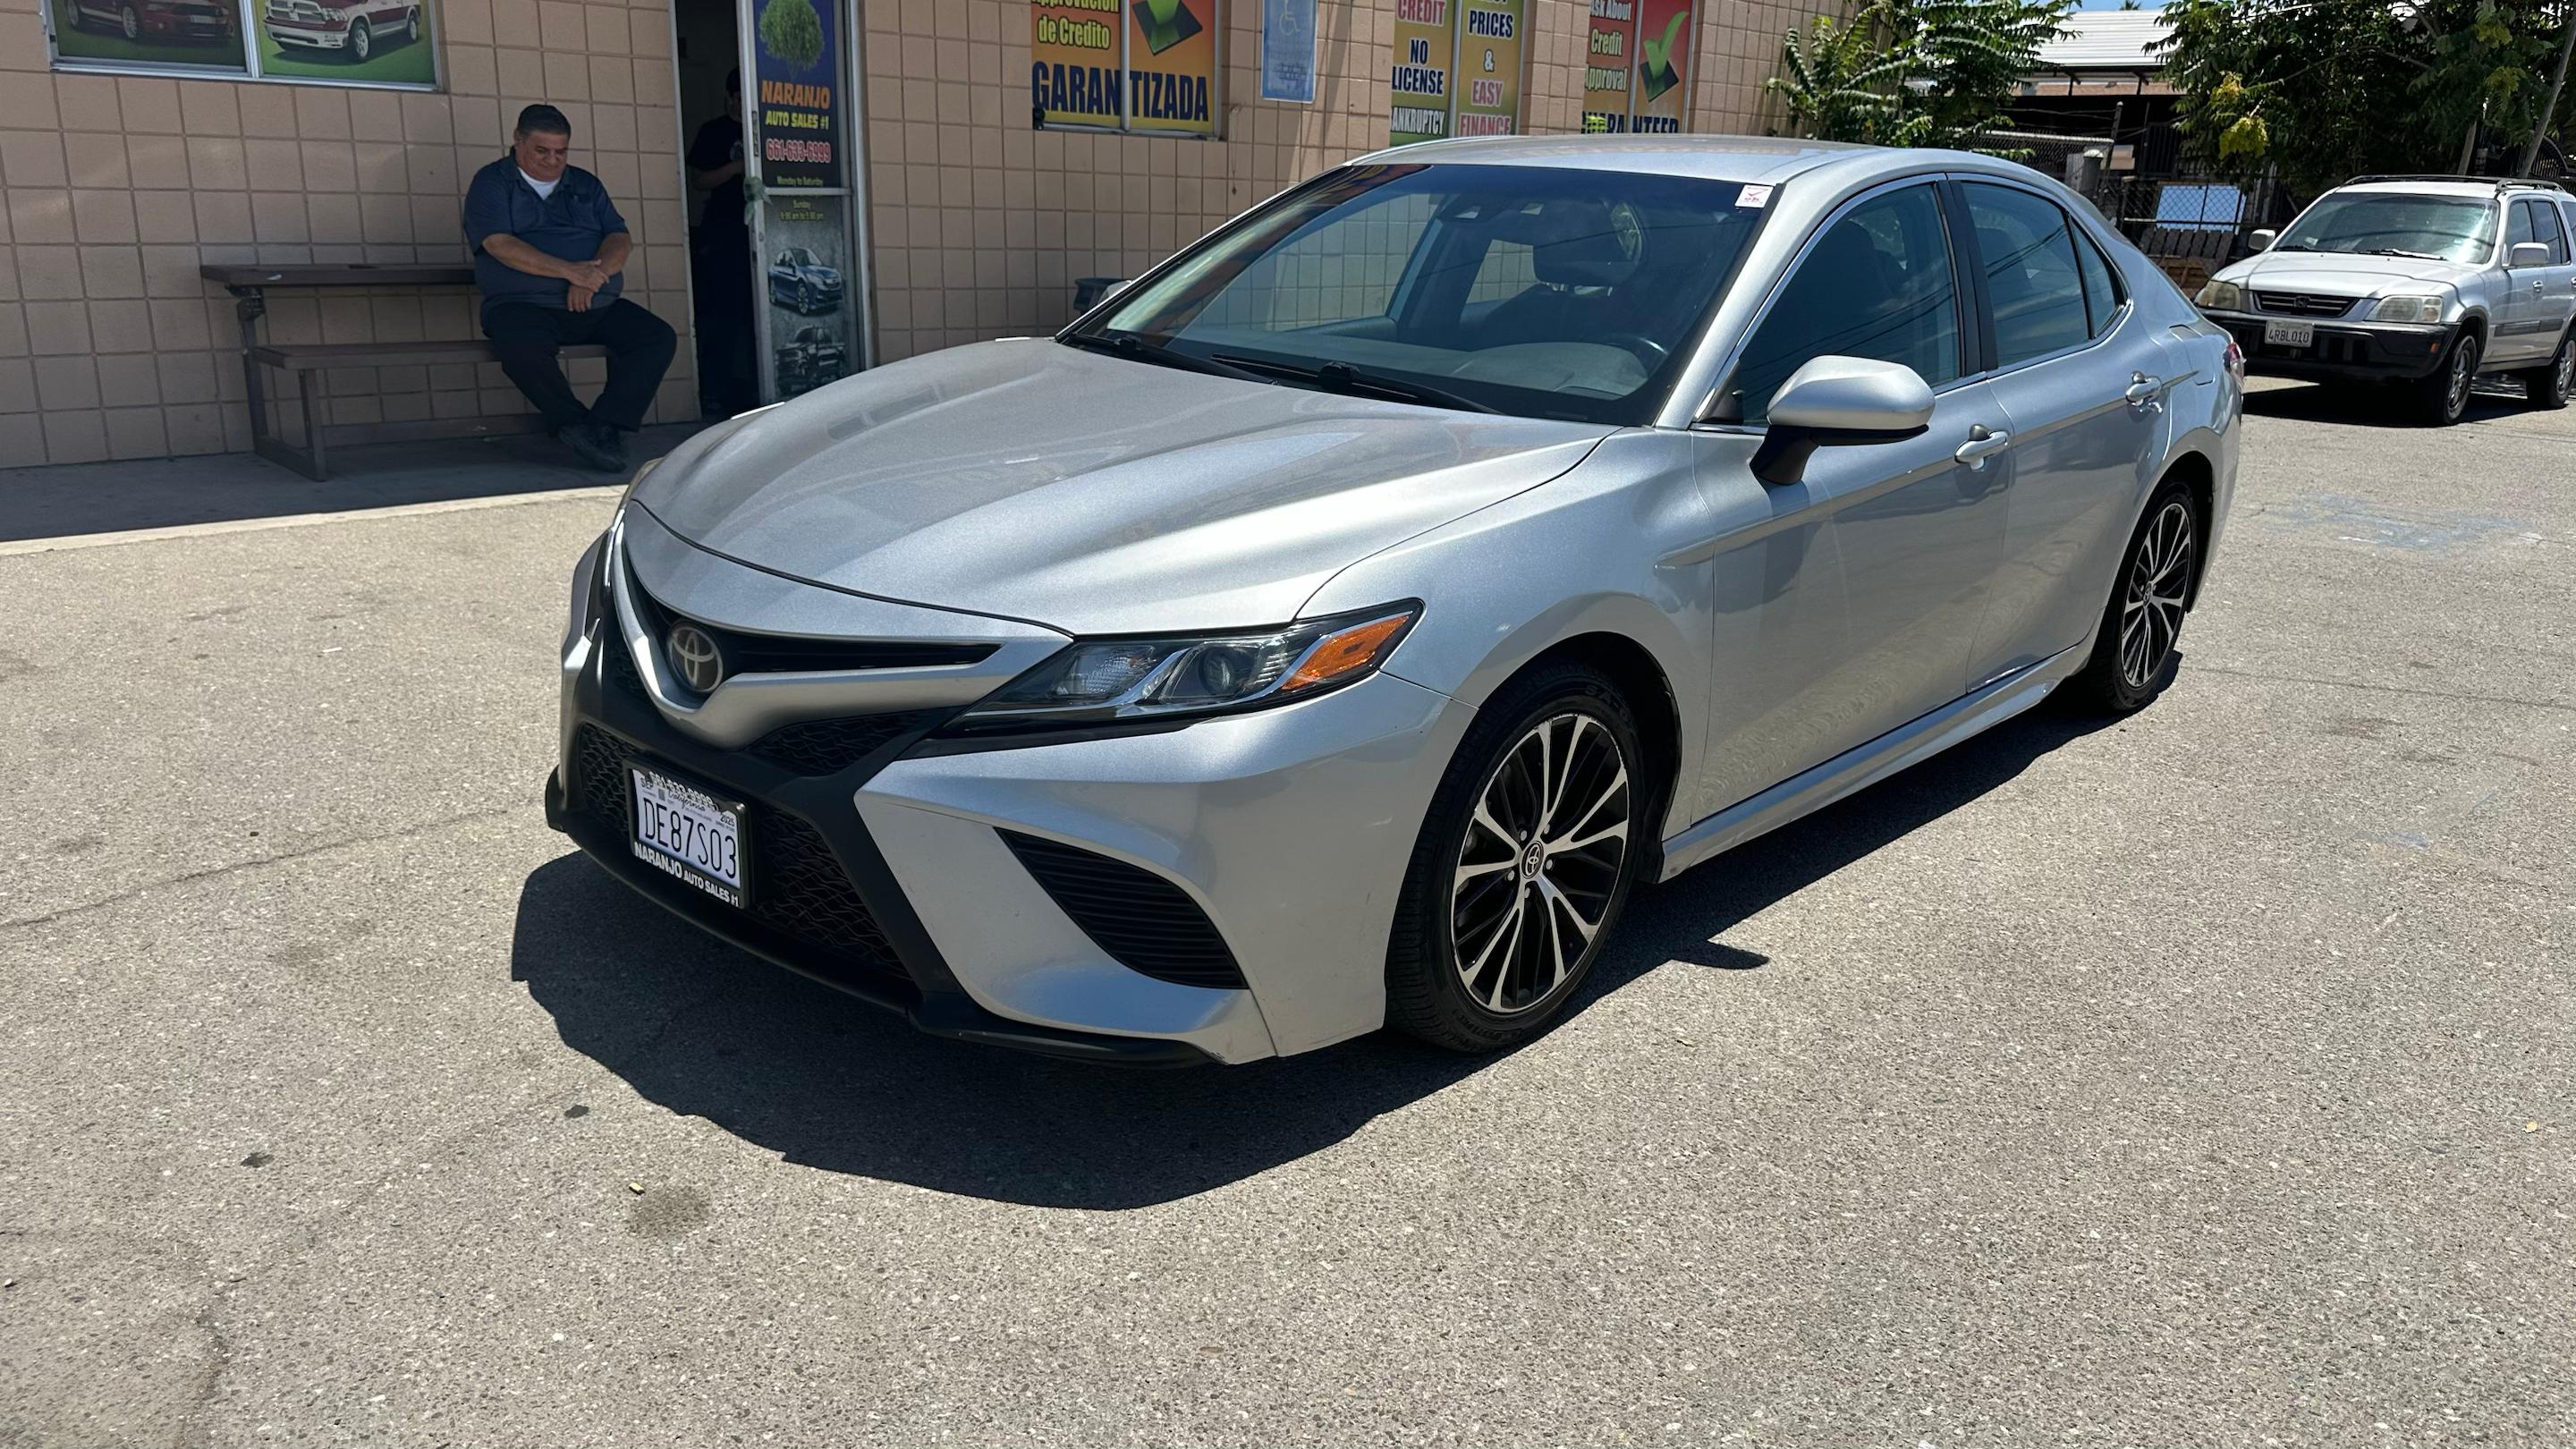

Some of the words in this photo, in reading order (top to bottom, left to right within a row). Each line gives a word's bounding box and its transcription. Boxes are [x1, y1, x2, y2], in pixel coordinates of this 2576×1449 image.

[1397, 0, 1445, 26] CREDIT
[1469, 9, 1513, 38] PRICES
[1606, 0, 1631, 21] About
[1038, 15, 1056, 43] de
[1058, 17, 1111, 50] Credito
[1590, 28, 1623, 55] Credit
[1410, 38, 1428, 65] NO
[1484, 49, 1495, 72] &
[761, 80, 831, 109] NARANJO
[1032, 61, 1209, 123] GARANTIZADA
[1392, 66, 1445, 96] LICENSE
[1472, 80, 1504, 106] EASY
[766, 110, 790, 127] AUTO
[791, 112, 819, 130] SALES
[820, 114, 830, 130] #1
[1391, 106, 1445, 135] ANKRUPTCY
[1460, 114, 1512, 136] FINANCE
[2268, 329, 2310, 343] 4RBL010
[643, 797, 737, 880] DE87S03
[634, 841, 682, 879] NARANJO
[683, 869, 704, 890] AUTO
[704, 879, 730, 903] SALES
[731, 894, 740, 908] #1
